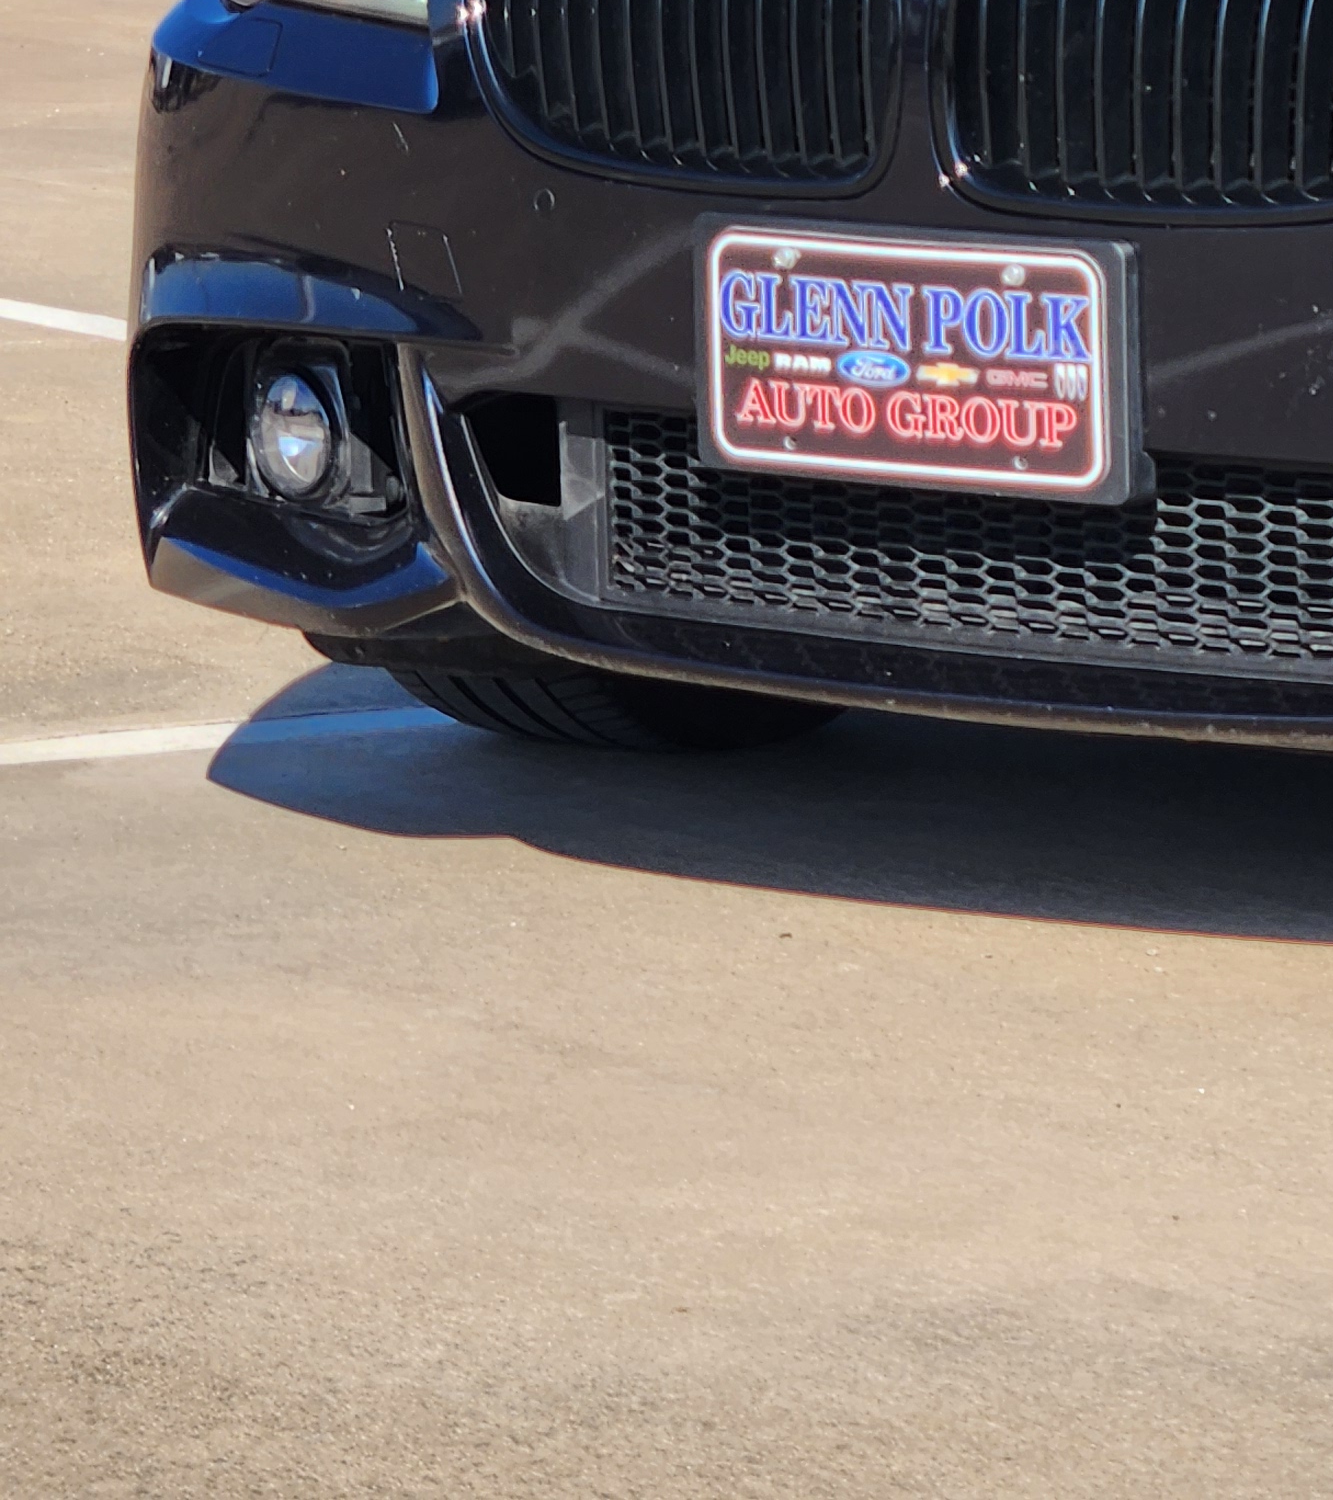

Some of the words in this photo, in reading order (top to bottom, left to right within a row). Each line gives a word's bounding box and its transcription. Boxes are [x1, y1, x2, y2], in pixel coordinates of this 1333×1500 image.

[720, 271, 911, 350] GLENN
[923, 285, 1092, 360] POLK
[724, 346, 770, 370] Jeep
[774, 354, 831, 372] RAM
[850, 355, 897, 382] Ford
[985, 369, 1048, 389] GMC
[737, 380, 876, 433] AUTO
[886, 392, 1077, 448] GROUP
